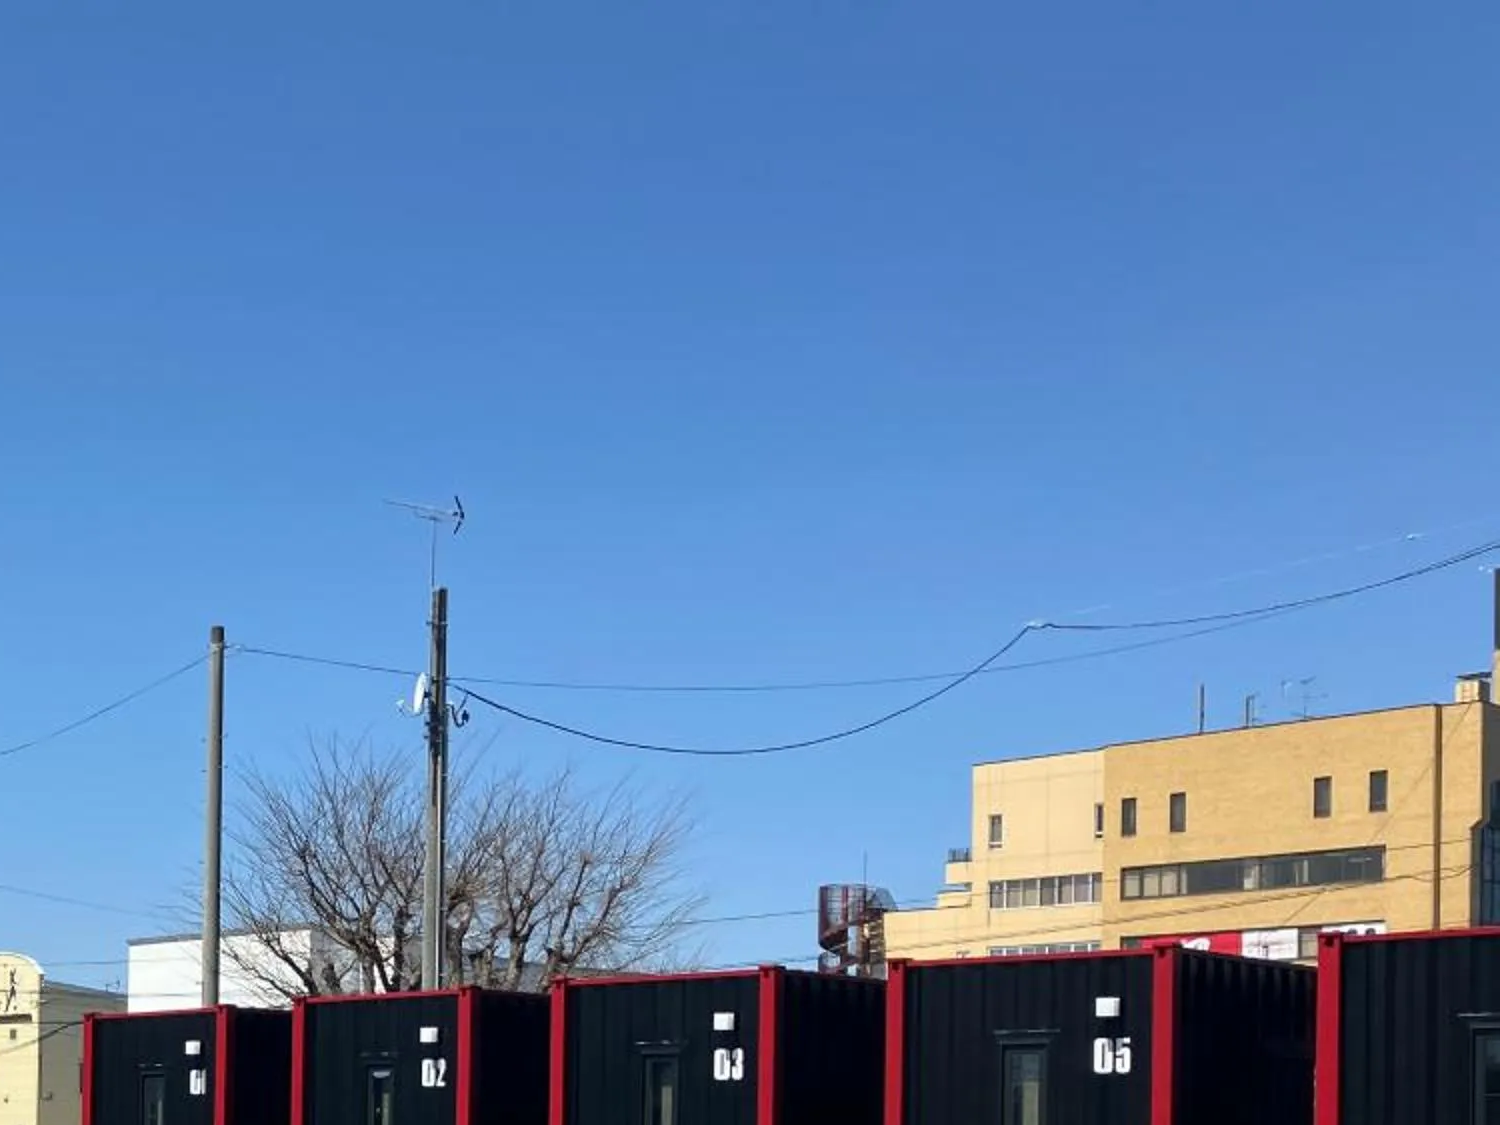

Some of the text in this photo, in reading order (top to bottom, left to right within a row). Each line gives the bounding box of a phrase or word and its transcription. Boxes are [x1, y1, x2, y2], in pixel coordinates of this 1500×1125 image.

[713, 1048, 744, 1080] 03
[1093, 1037, 1132, 1074] 05
[421, 1058, 446, 1087] 02
